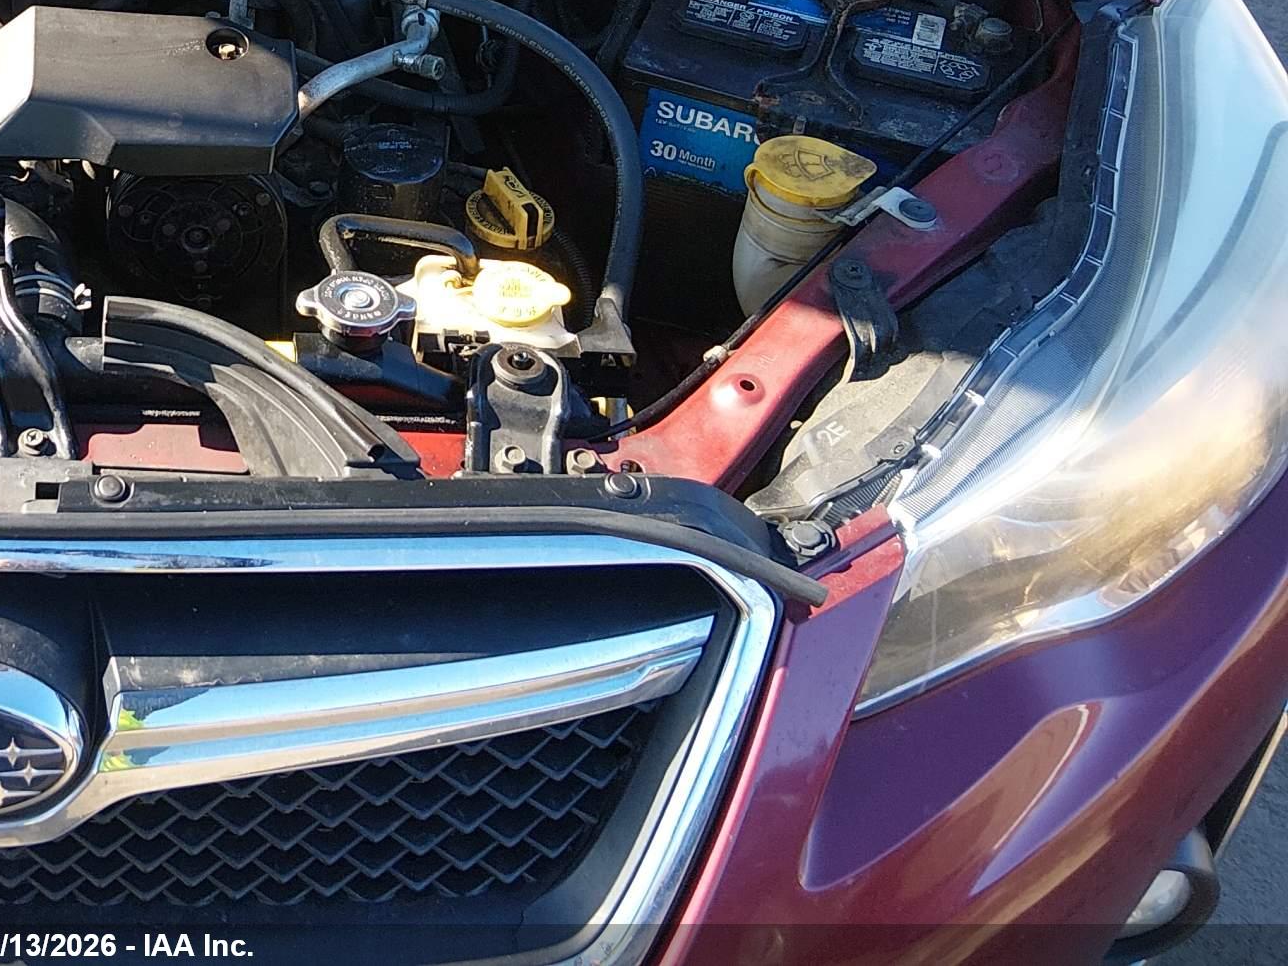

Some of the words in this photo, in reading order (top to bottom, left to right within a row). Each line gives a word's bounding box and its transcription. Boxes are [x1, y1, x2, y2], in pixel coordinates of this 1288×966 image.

[756, 7, 794, 22] POISON
[650, 140, 677, 161] 30
[678, 148, 716, 169] Month
[816, 420, 851, 447] 2E
